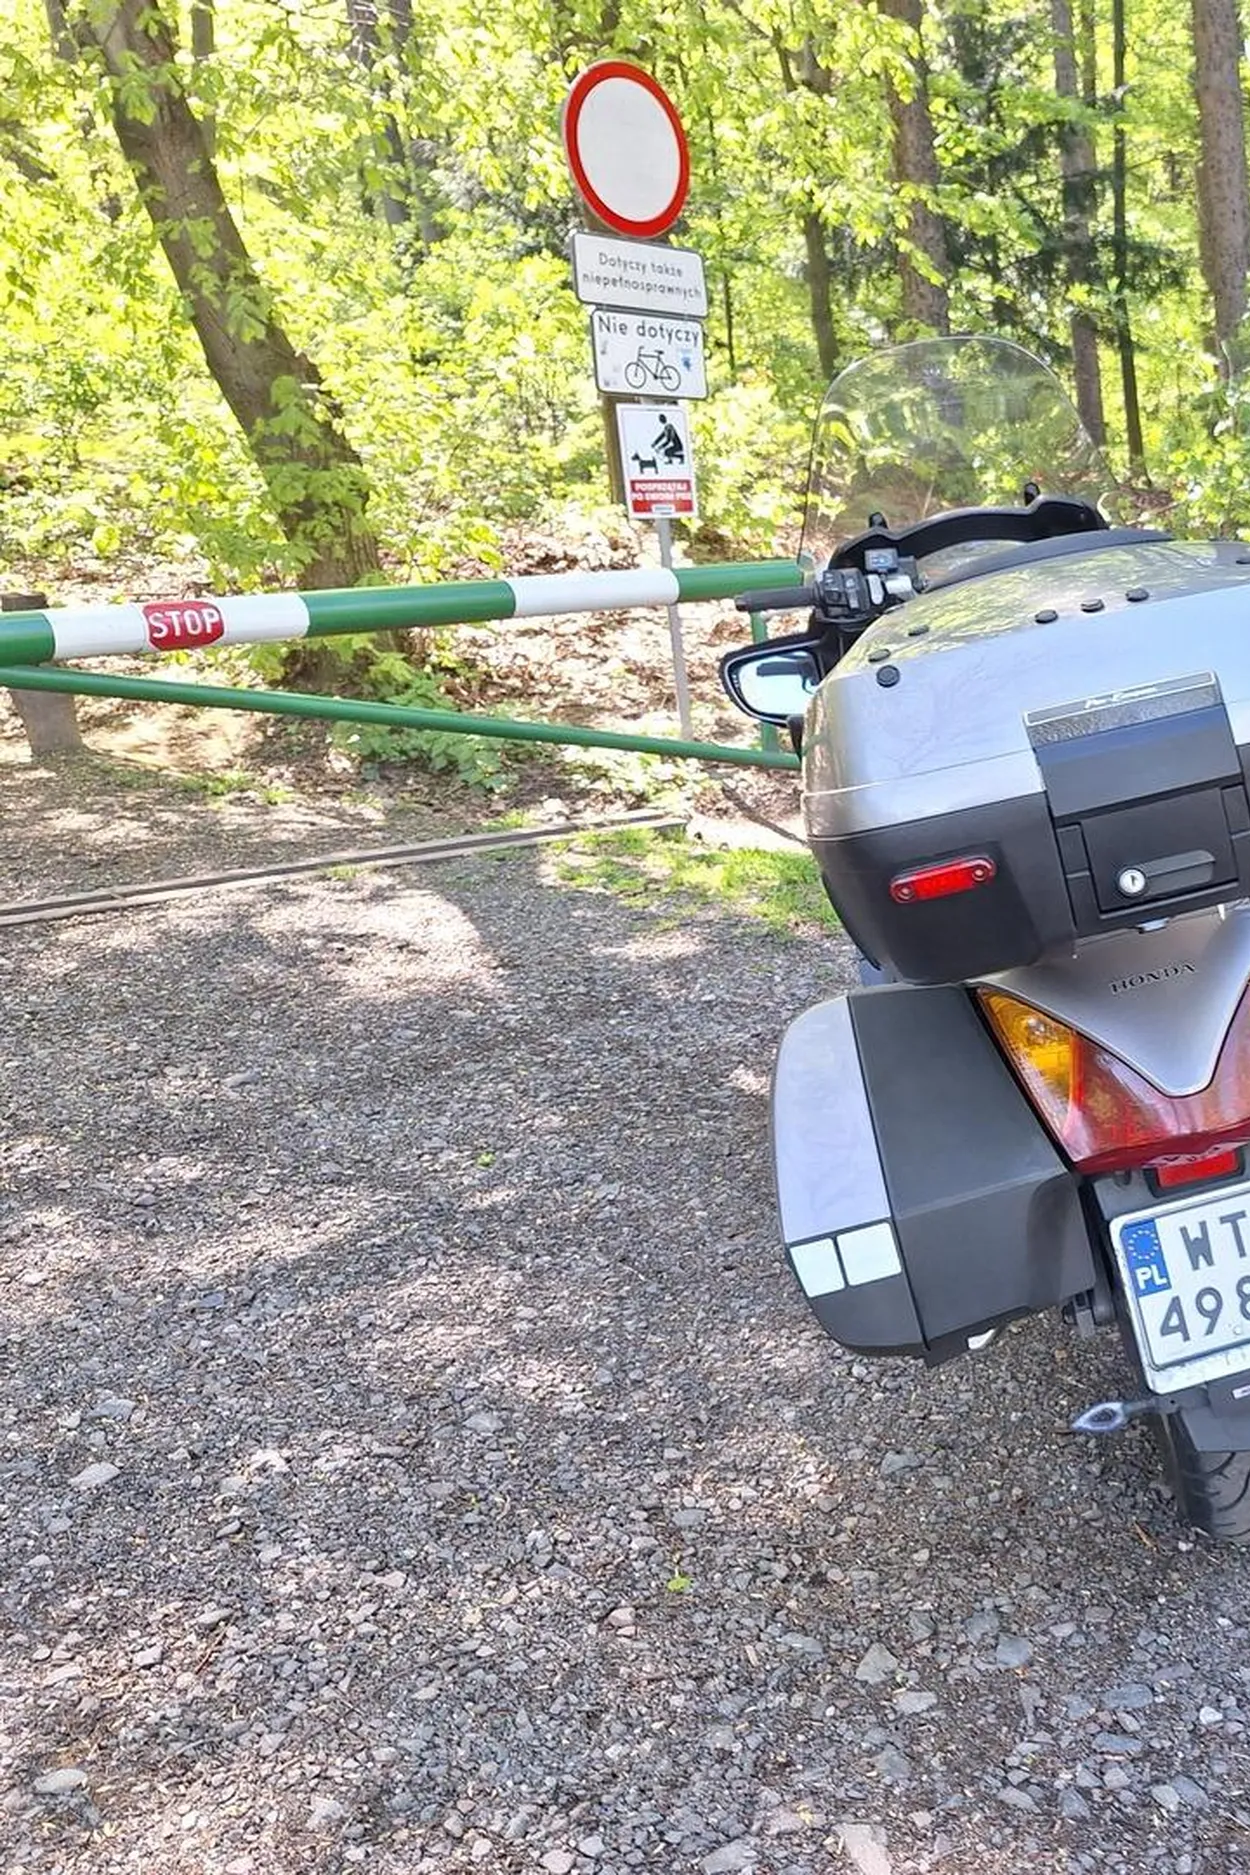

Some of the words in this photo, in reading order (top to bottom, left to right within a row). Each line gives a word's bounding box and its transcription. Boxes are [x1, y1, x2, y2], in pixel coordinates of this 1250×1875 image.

[598, 252, 646, 275] Dotyczy
[582, 272, 701, 299] niepełnosprawnych
[598, 315, 628, 336] Nie
[637, 320, 700, 348] dotyczy
[148, 608, 220, 639] STOP
[1110, 963, 1196, 995] HONDA
[1179, 1210, 1248, 1271] WT
[1134, 1266, 1167, 1290] PL
